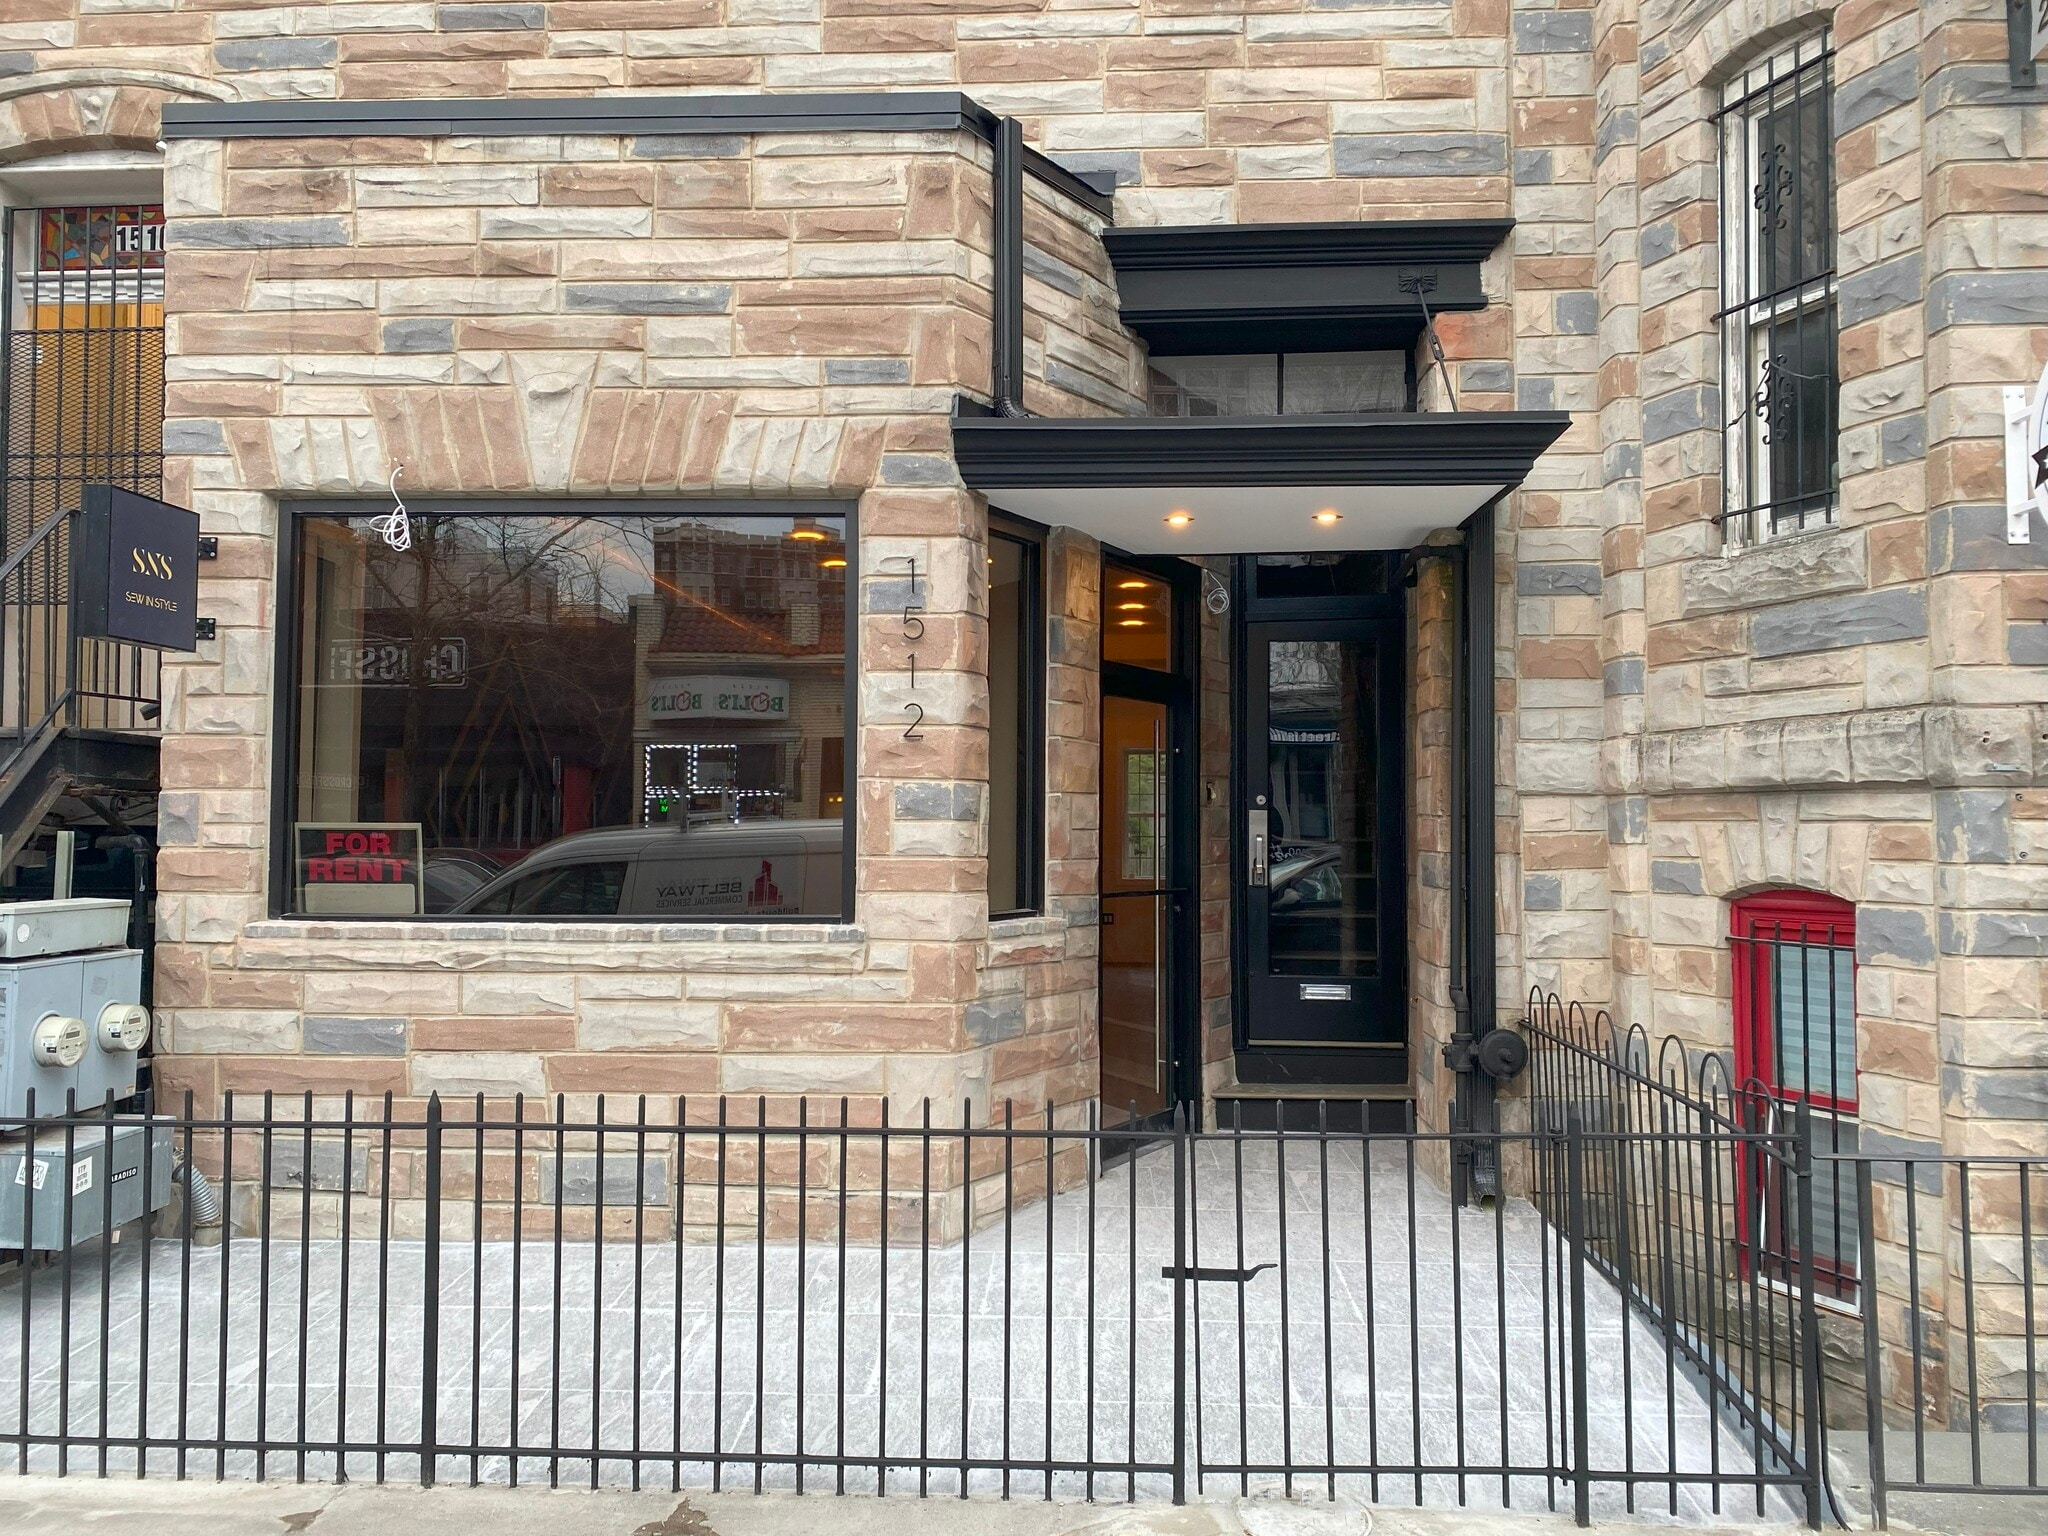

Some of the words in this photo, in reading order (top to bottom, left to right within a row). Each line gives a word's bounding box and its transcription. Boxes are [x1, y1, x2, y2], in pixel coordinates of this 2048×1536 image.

[117, 226, 164, 251] 151
[132, 547, 173, 581] SNS
[125, 590, 144, 605] SEW
[145, 596, 154, 607] IN
[155, 599, 178, 612] STYLE
[902, 558, 925, 738] 1512
[325, 832, 391, 855] FOR
[308, 857, 410, 881] RENT
[112, 1167, 138, 1183] ARADISO
